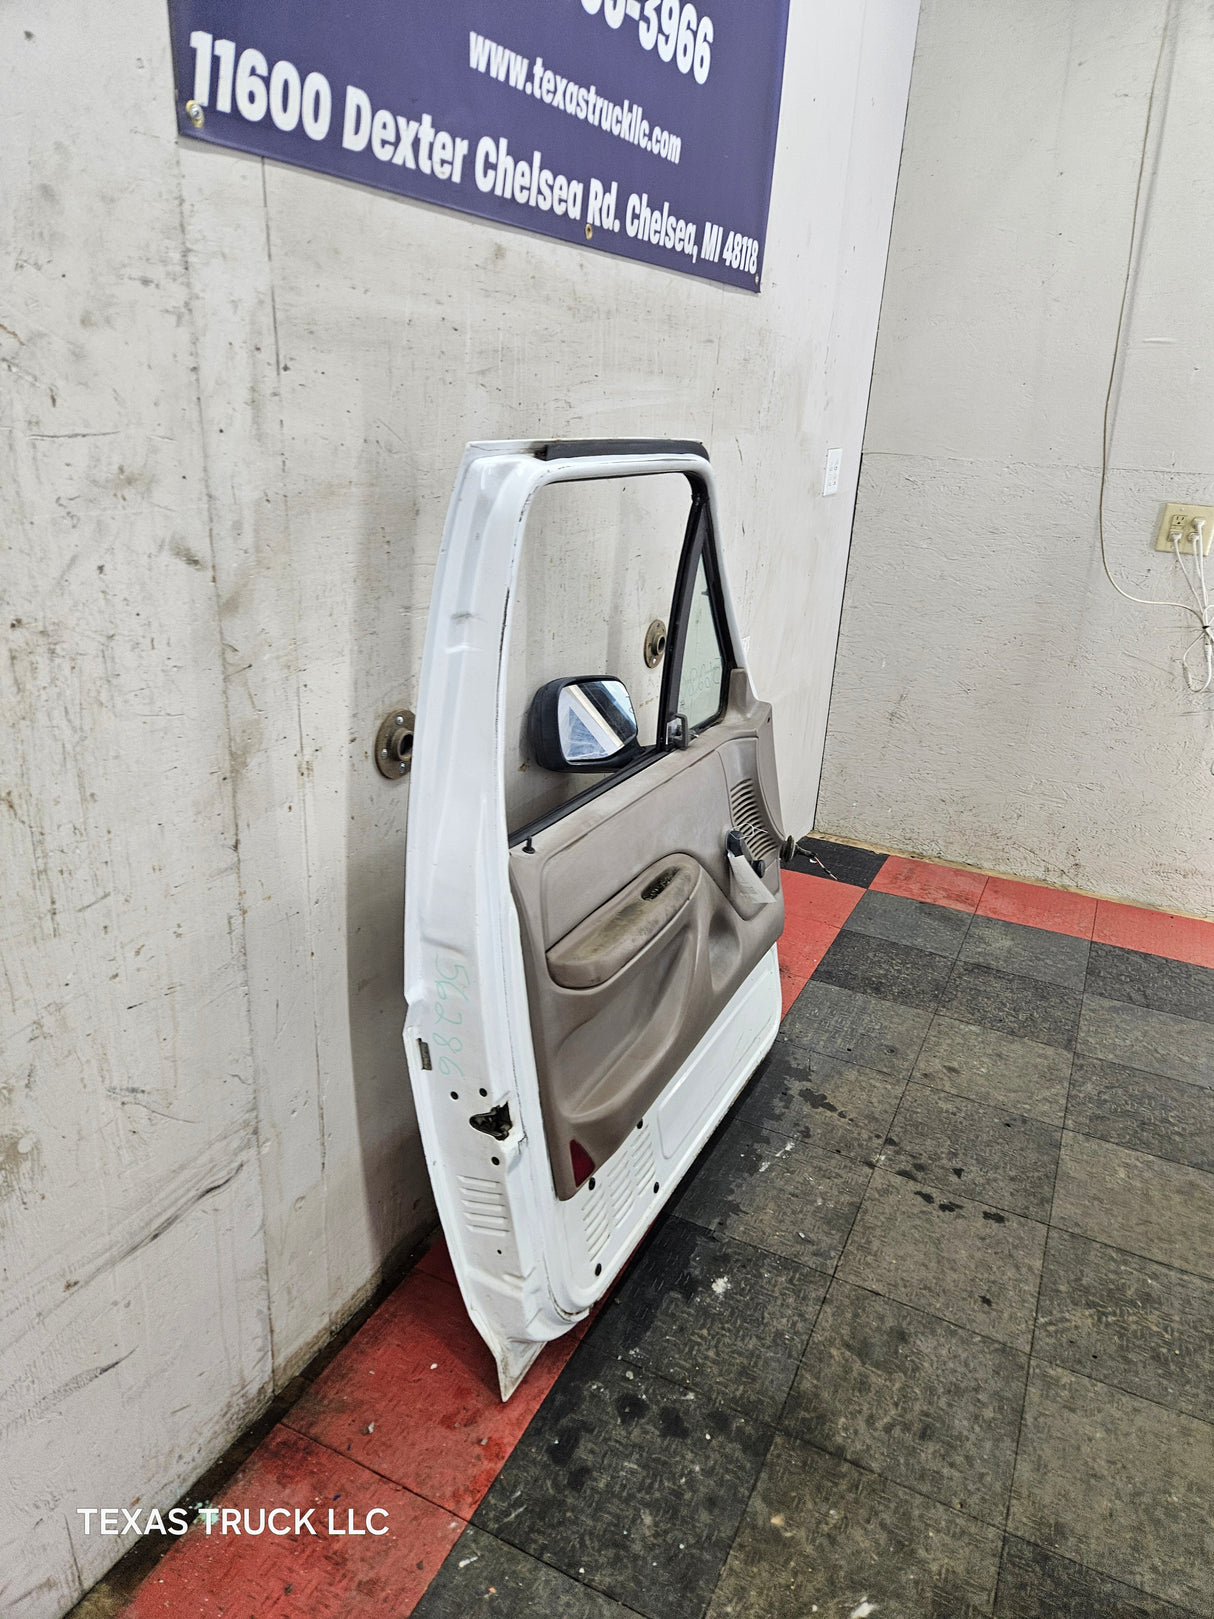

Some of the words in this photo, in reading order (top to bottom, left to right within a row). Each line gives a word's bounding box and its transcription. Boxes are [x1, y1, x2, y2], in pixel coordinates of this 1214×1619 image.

[190, 31, 332, 140] 11600
[343, 85, 469, 183] Dexter
[474, 136, 583, 220] Chelsea
[587, 178, 620, 232] Rd.
[626, 193, 698, 263] Chelsea,
[701, 222, 723, 262] MI
[723, 231, 759, 274] 48118
[469, 31, 682, 164] www.texastruckllc.com
[432, 954, 471, 1077] 56286
